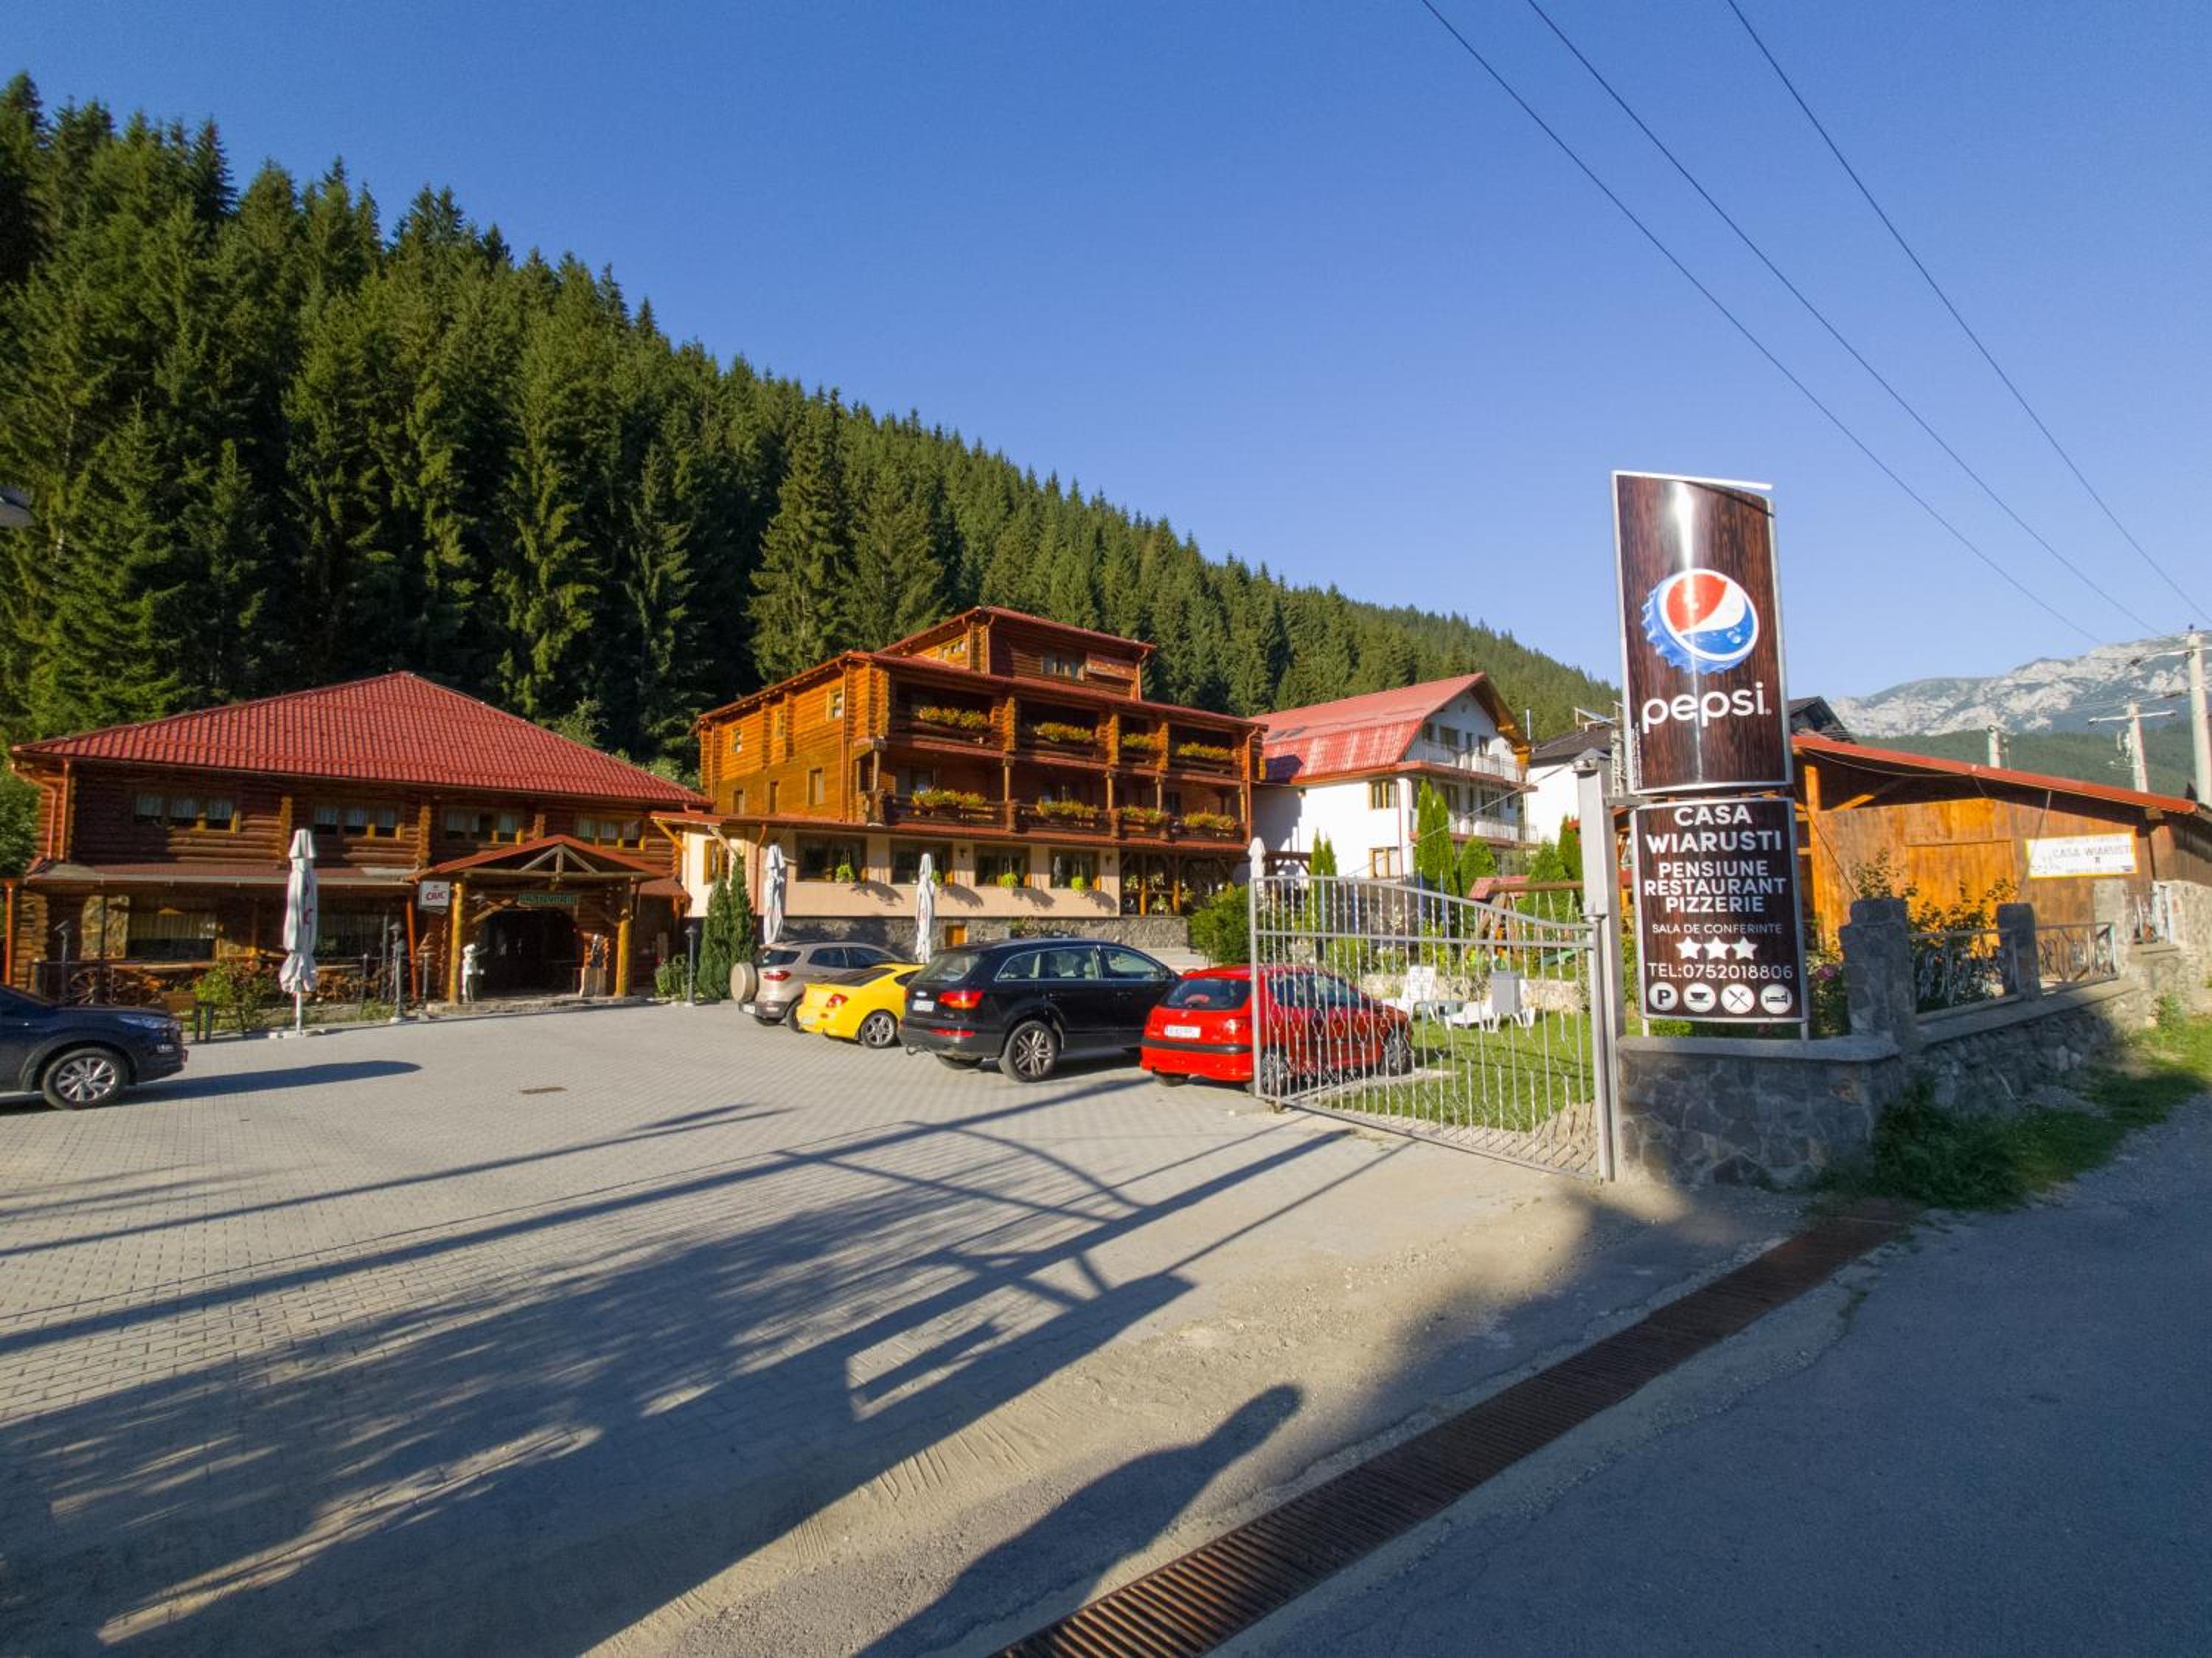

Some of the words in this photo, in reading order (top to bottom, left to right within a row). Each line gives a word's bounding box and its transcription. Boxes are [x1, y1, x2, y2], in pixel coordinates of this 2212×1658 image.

[1674, 805, 1753, 827] CASA
[1646, 830, 1781, 854] WIARUSTI
[1659, 860, 1769, 878] PENSIUNE
[1644, 878, 1787, 896] RESTAURANT
[1666, 896, 1764, 913] PIZZERIE
[1652, 924, 1680, 934] SALA
[1683, 924, 1700, 934] DE
[1703, 923, 1782, 934] CONFERINTE
[1647, 962, 1793, 979] TEL:0752018806
